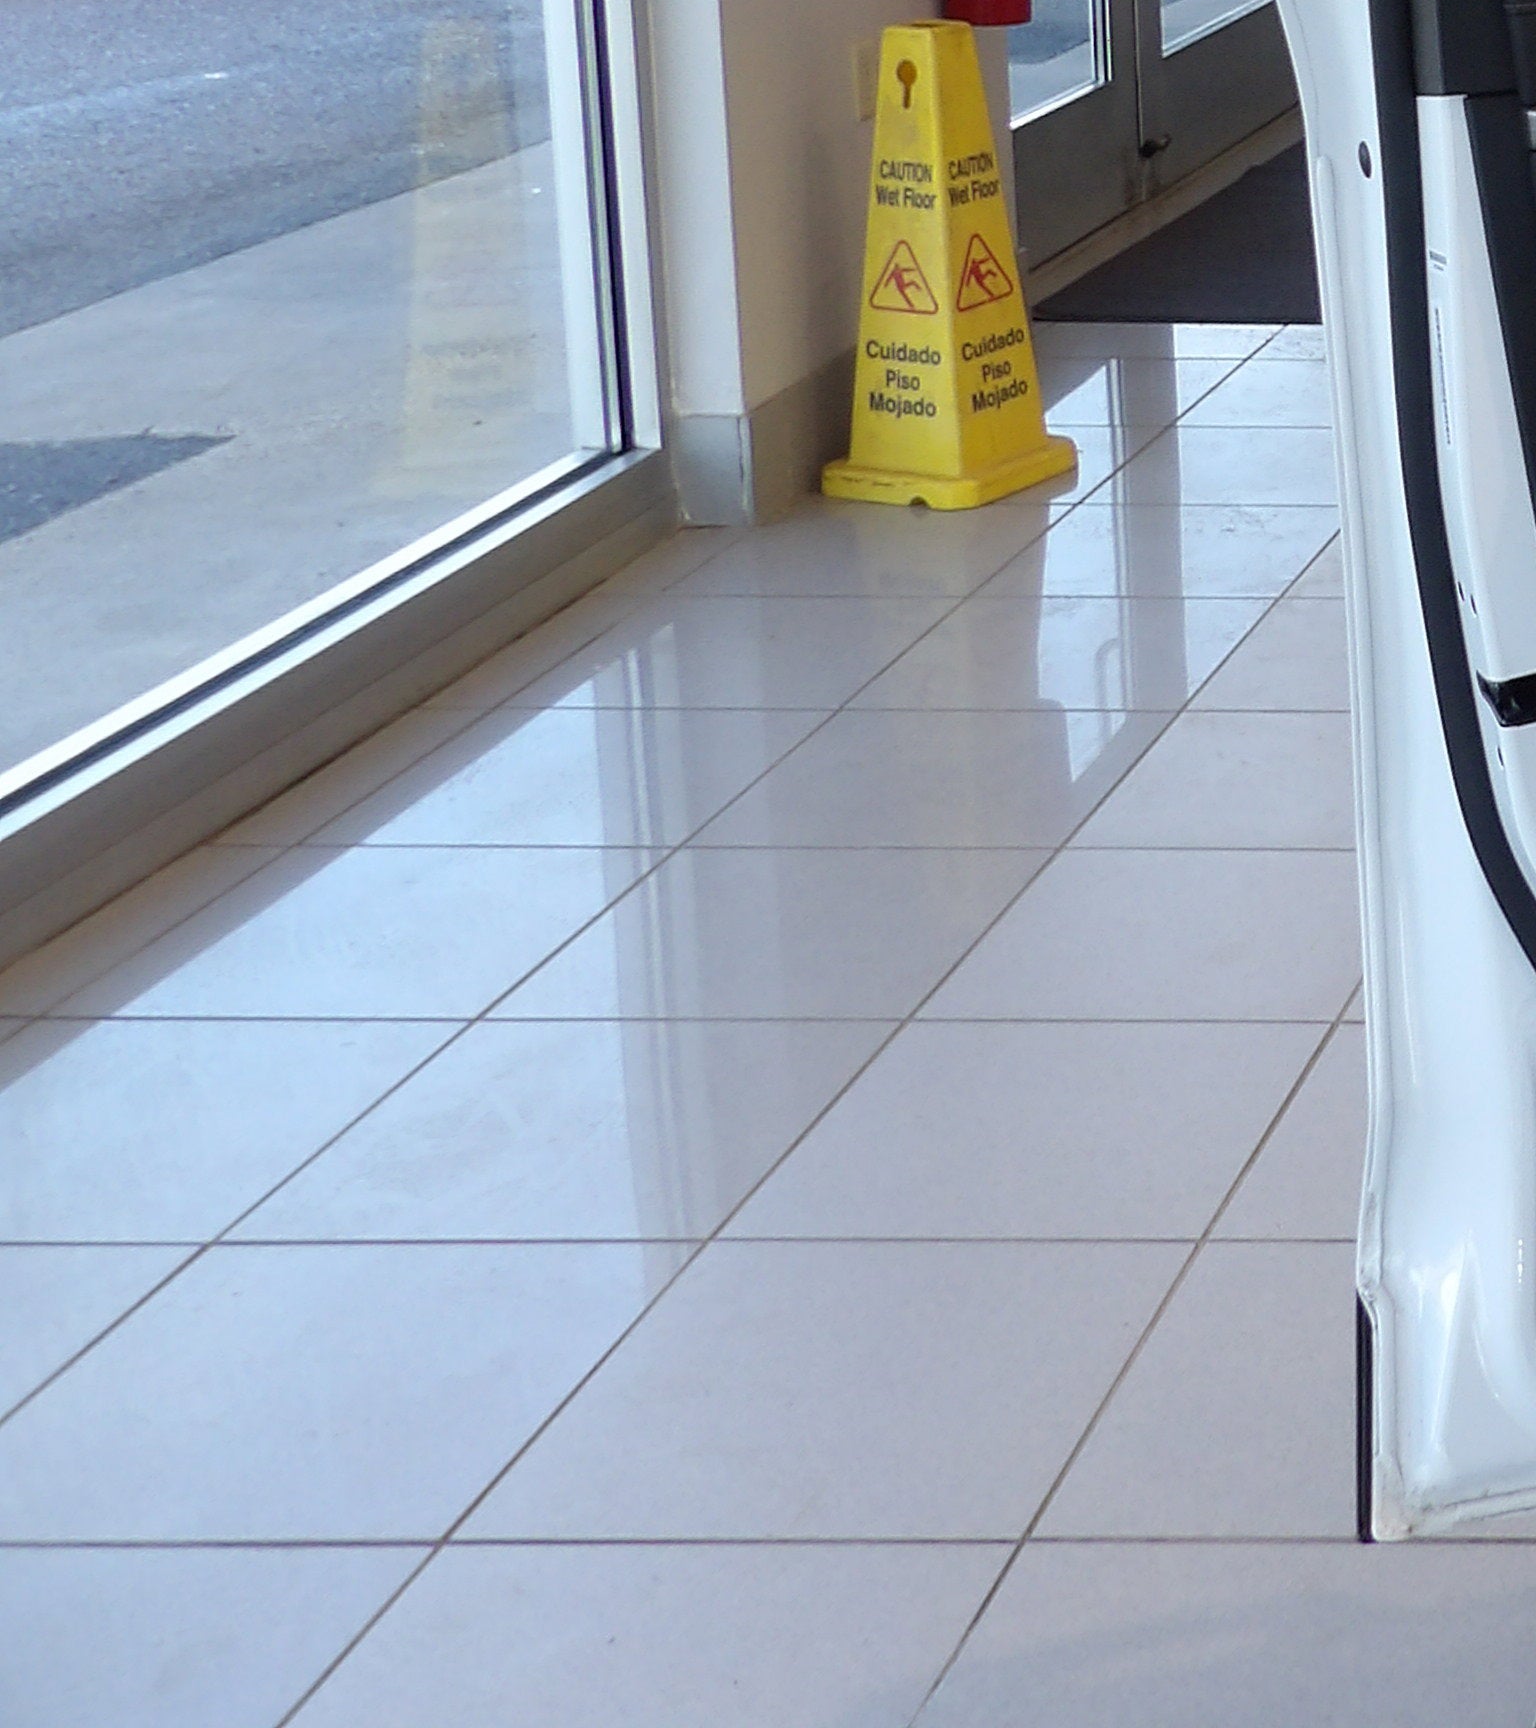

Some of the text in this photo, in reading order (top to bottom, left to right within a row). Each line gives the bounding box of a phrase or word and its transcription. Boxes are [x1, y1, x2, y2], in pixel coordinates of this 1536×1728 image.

[879, 158, 934, 183] CAUTION
[947, 151, 995, 181] CAUTION
[875, 184, 937, 210] Wet Floor
[947, 178, 999, 208] Wet Floor
[865, 339, 942, 366] Cuidado
[961, 327, 1026, 362] Cuidado
[885, 369, 921, 391] Piso
[981, 361, 1012, 383] Piso
[868, 391, 937, 418] Mojado
[971, 378, 1028, 413] Mojado
